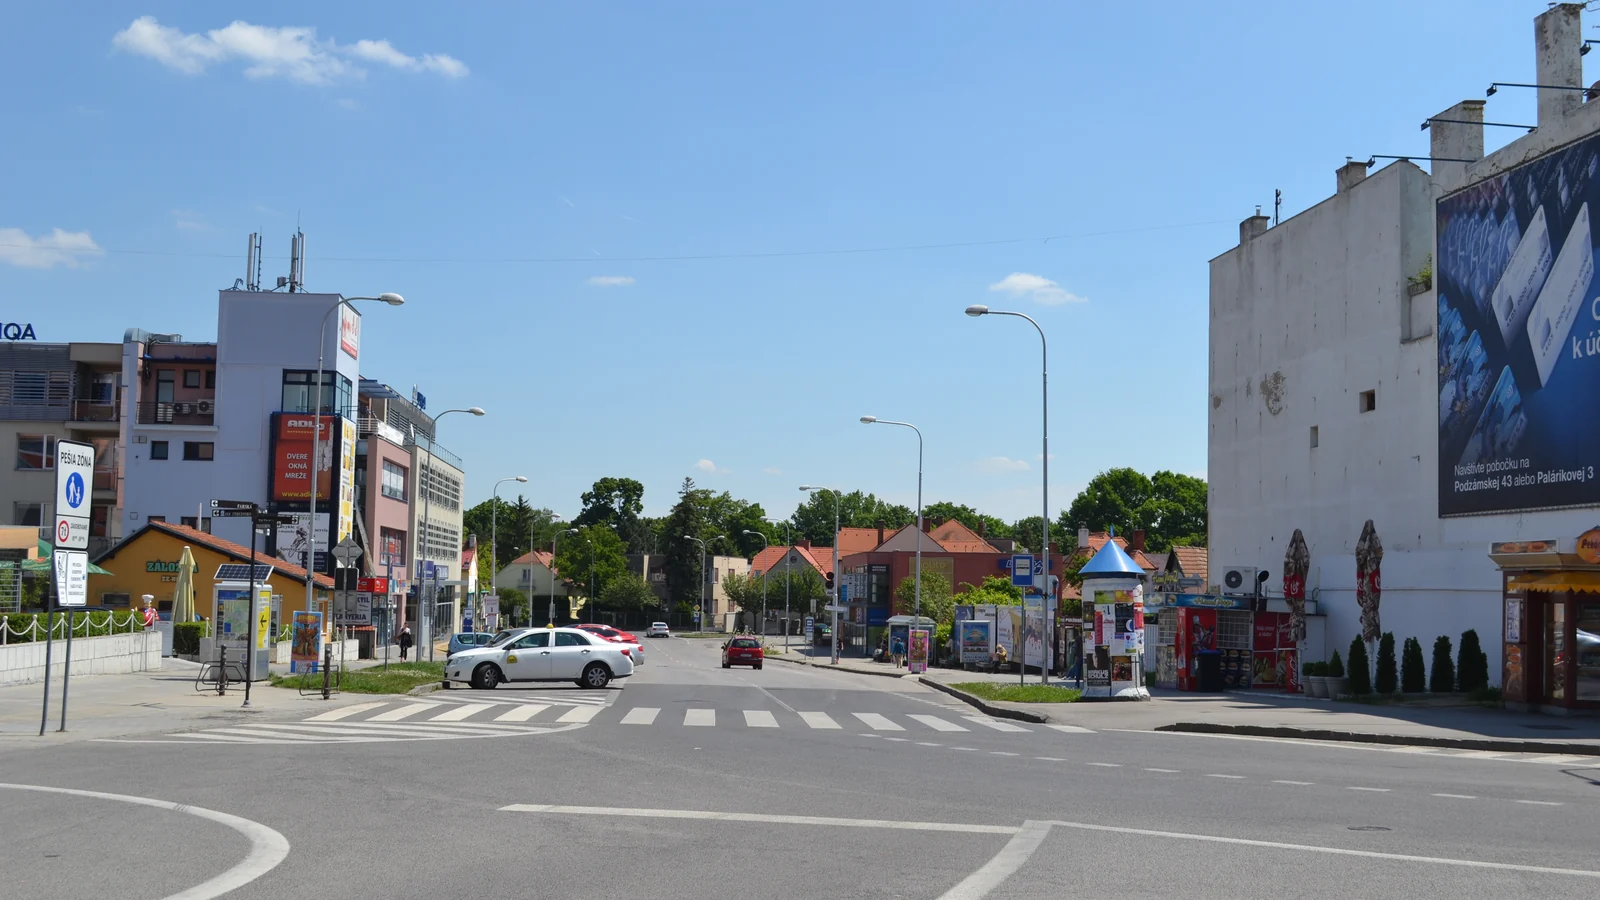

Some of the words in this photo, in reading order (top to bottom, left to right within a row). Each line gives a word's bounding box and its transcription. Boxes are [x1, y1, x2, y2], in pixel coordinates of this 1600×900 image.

[1573, 336, 1583, 359] k
[60, 450, 76, 466] PEŠIA
[77, 452, 92, 468] ZÓNA
[288, 461, 308, 469] OKNÁ
[1486, 458, 1518, 474] pobočku
[1520, 458, 1530, 468] na
[1454, 476, 1500, 492] Podzámskej
[1501, 475, 1512, 487] 43
[1514, 473, 1535, 486] alebo
[1537, 466, 1585, 483] Palárikovej
[1587, 466, 1594, 479] 3
[146, 559, 199, 573] ZÁLOŽA
